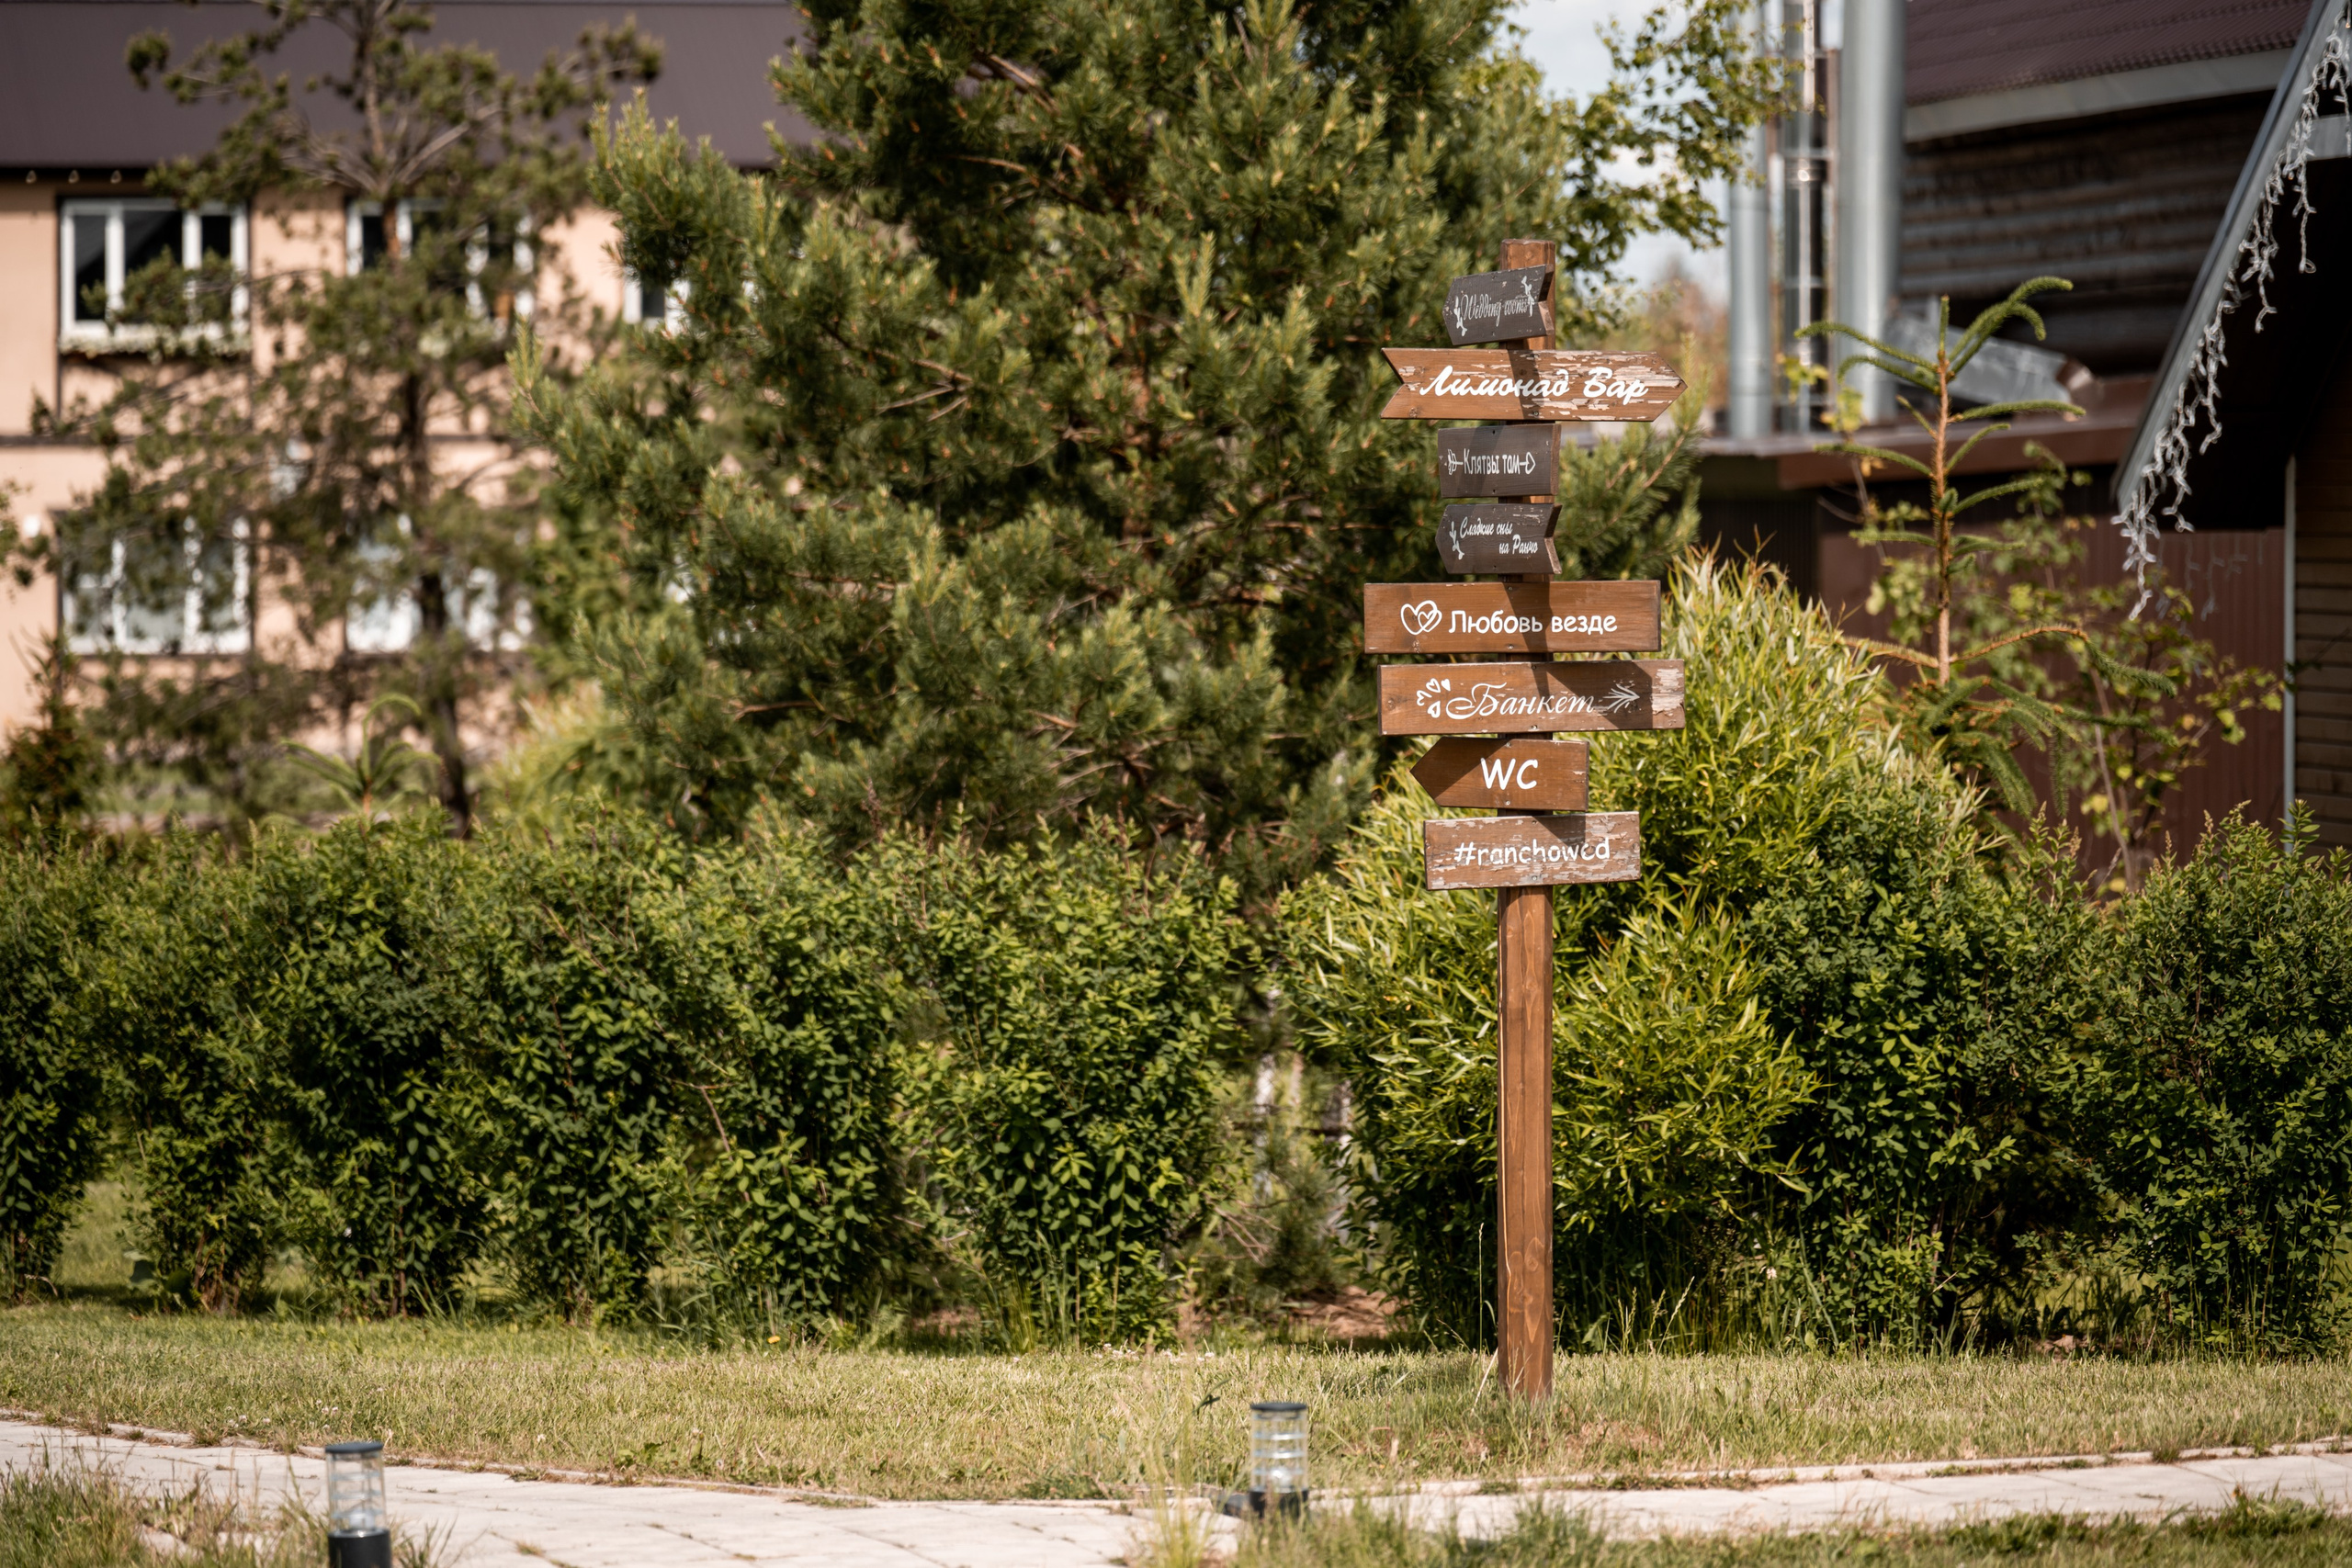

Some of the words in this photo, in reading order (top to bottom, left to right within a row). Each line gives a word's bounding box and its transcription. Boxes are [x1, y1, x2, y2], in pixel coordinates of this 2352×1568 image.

[1461, 293, 1501, 327] Wedding
[1419, 365, 1569, 397] Лимонад
[1464, 448, 1499, 475] Клятвы
[1502, 454, 1521, 475] там
[1460, 516, 1495, 539] Сладкие
[1496, 523, 1513, 536] сны
[1498, 542, 1510, 555] на
[1512, 534, 1539, 555] Ранчо
[1448, 610, 1543, 634] Любовь
[1551, 615, 1618, 635] везде
[1445, 682, 1594, 720] Банкет
[1480, 757, 1539, 791] WC
